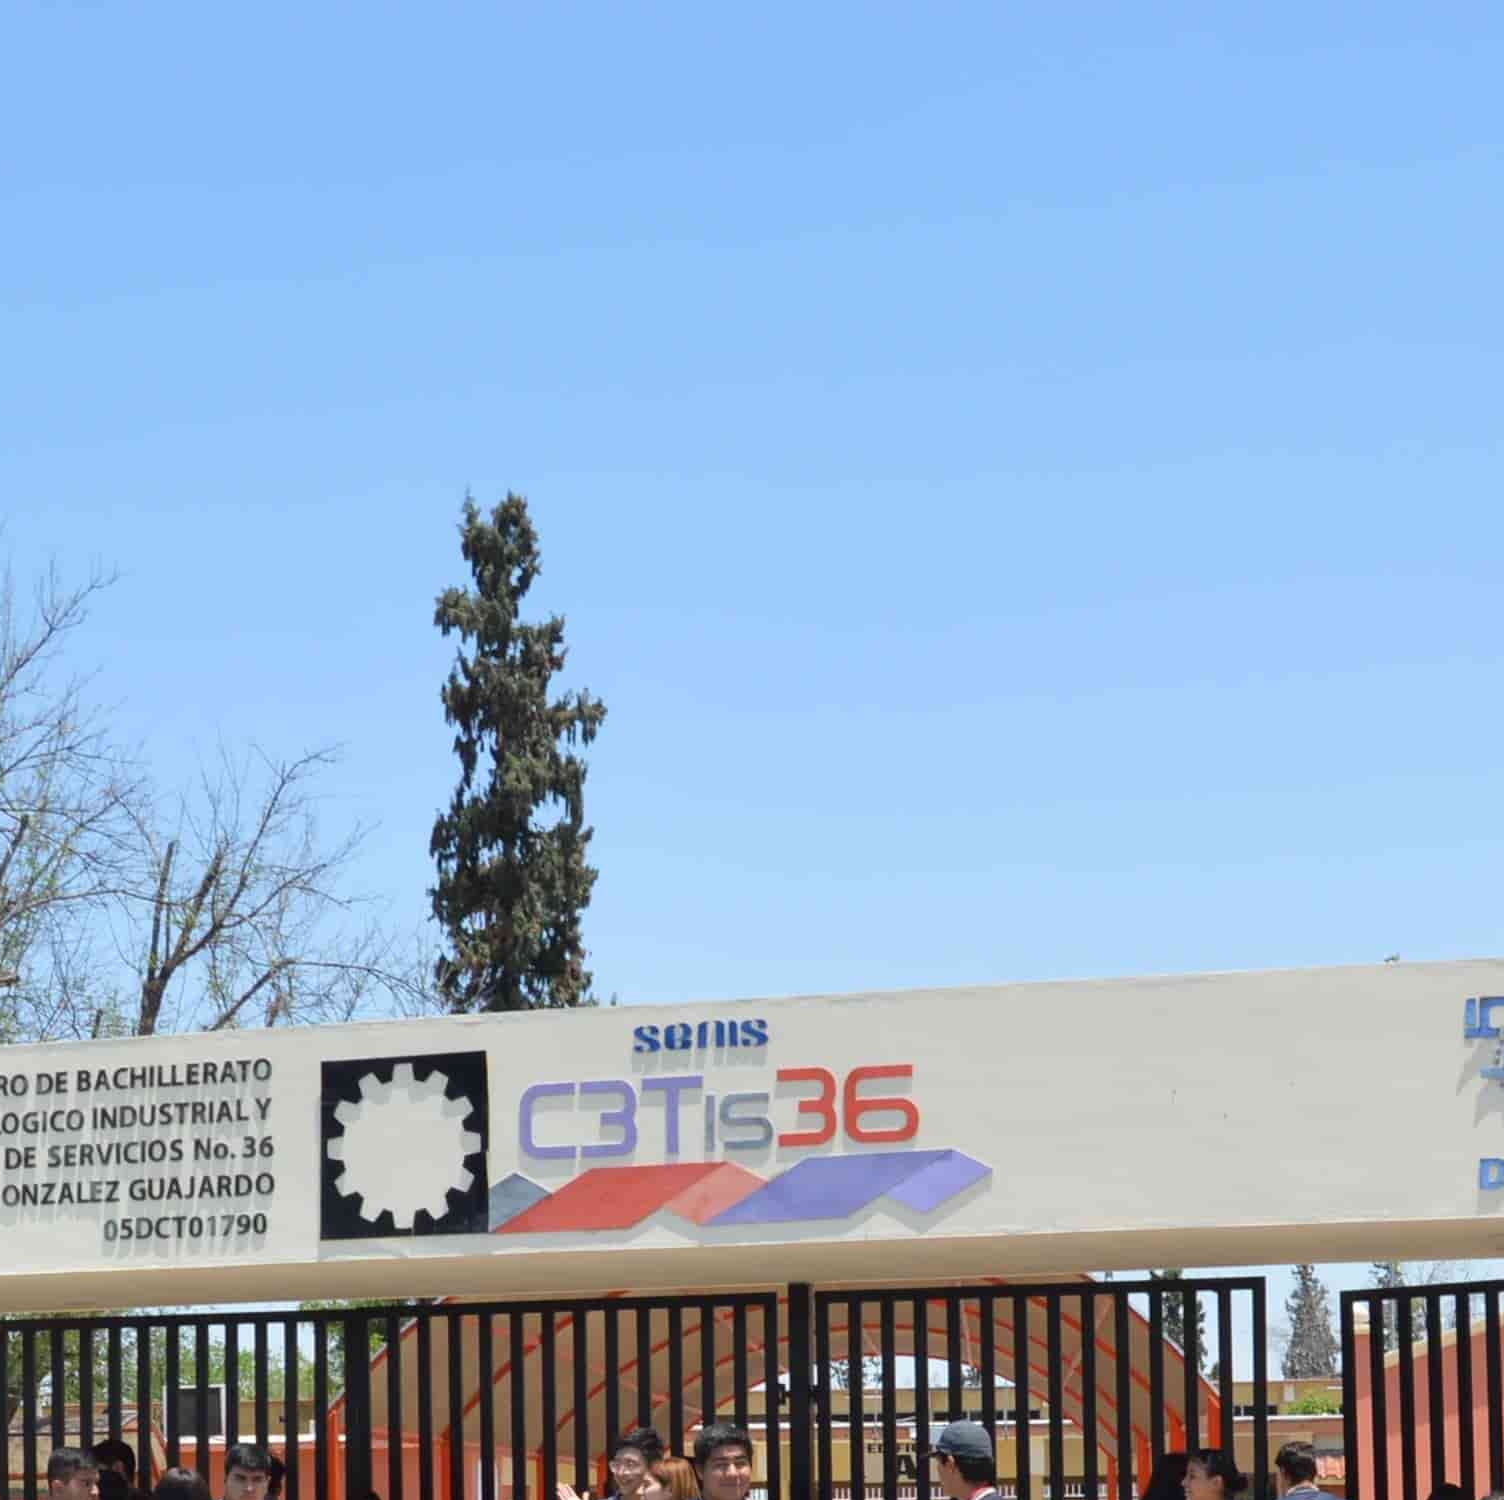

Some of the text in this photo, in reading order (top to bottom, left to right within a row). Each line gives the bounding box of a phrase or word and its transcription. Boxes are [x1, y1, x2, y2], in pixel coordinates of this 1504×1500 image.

[36, 1071, 69, 1095] DE
[76, 1058, 273, 1092] BACHILLERATO
[92, 1099, 249, 1130] INDUSTRIAL
[255, 1097, 272, 1121] Y
[5, 1136, 275, 1170] DE SERVICIOS No. 36
[128, 1172, 276, 1201] GUAJARDO
[103, 1212, 268, 1241] 05DCT01790
